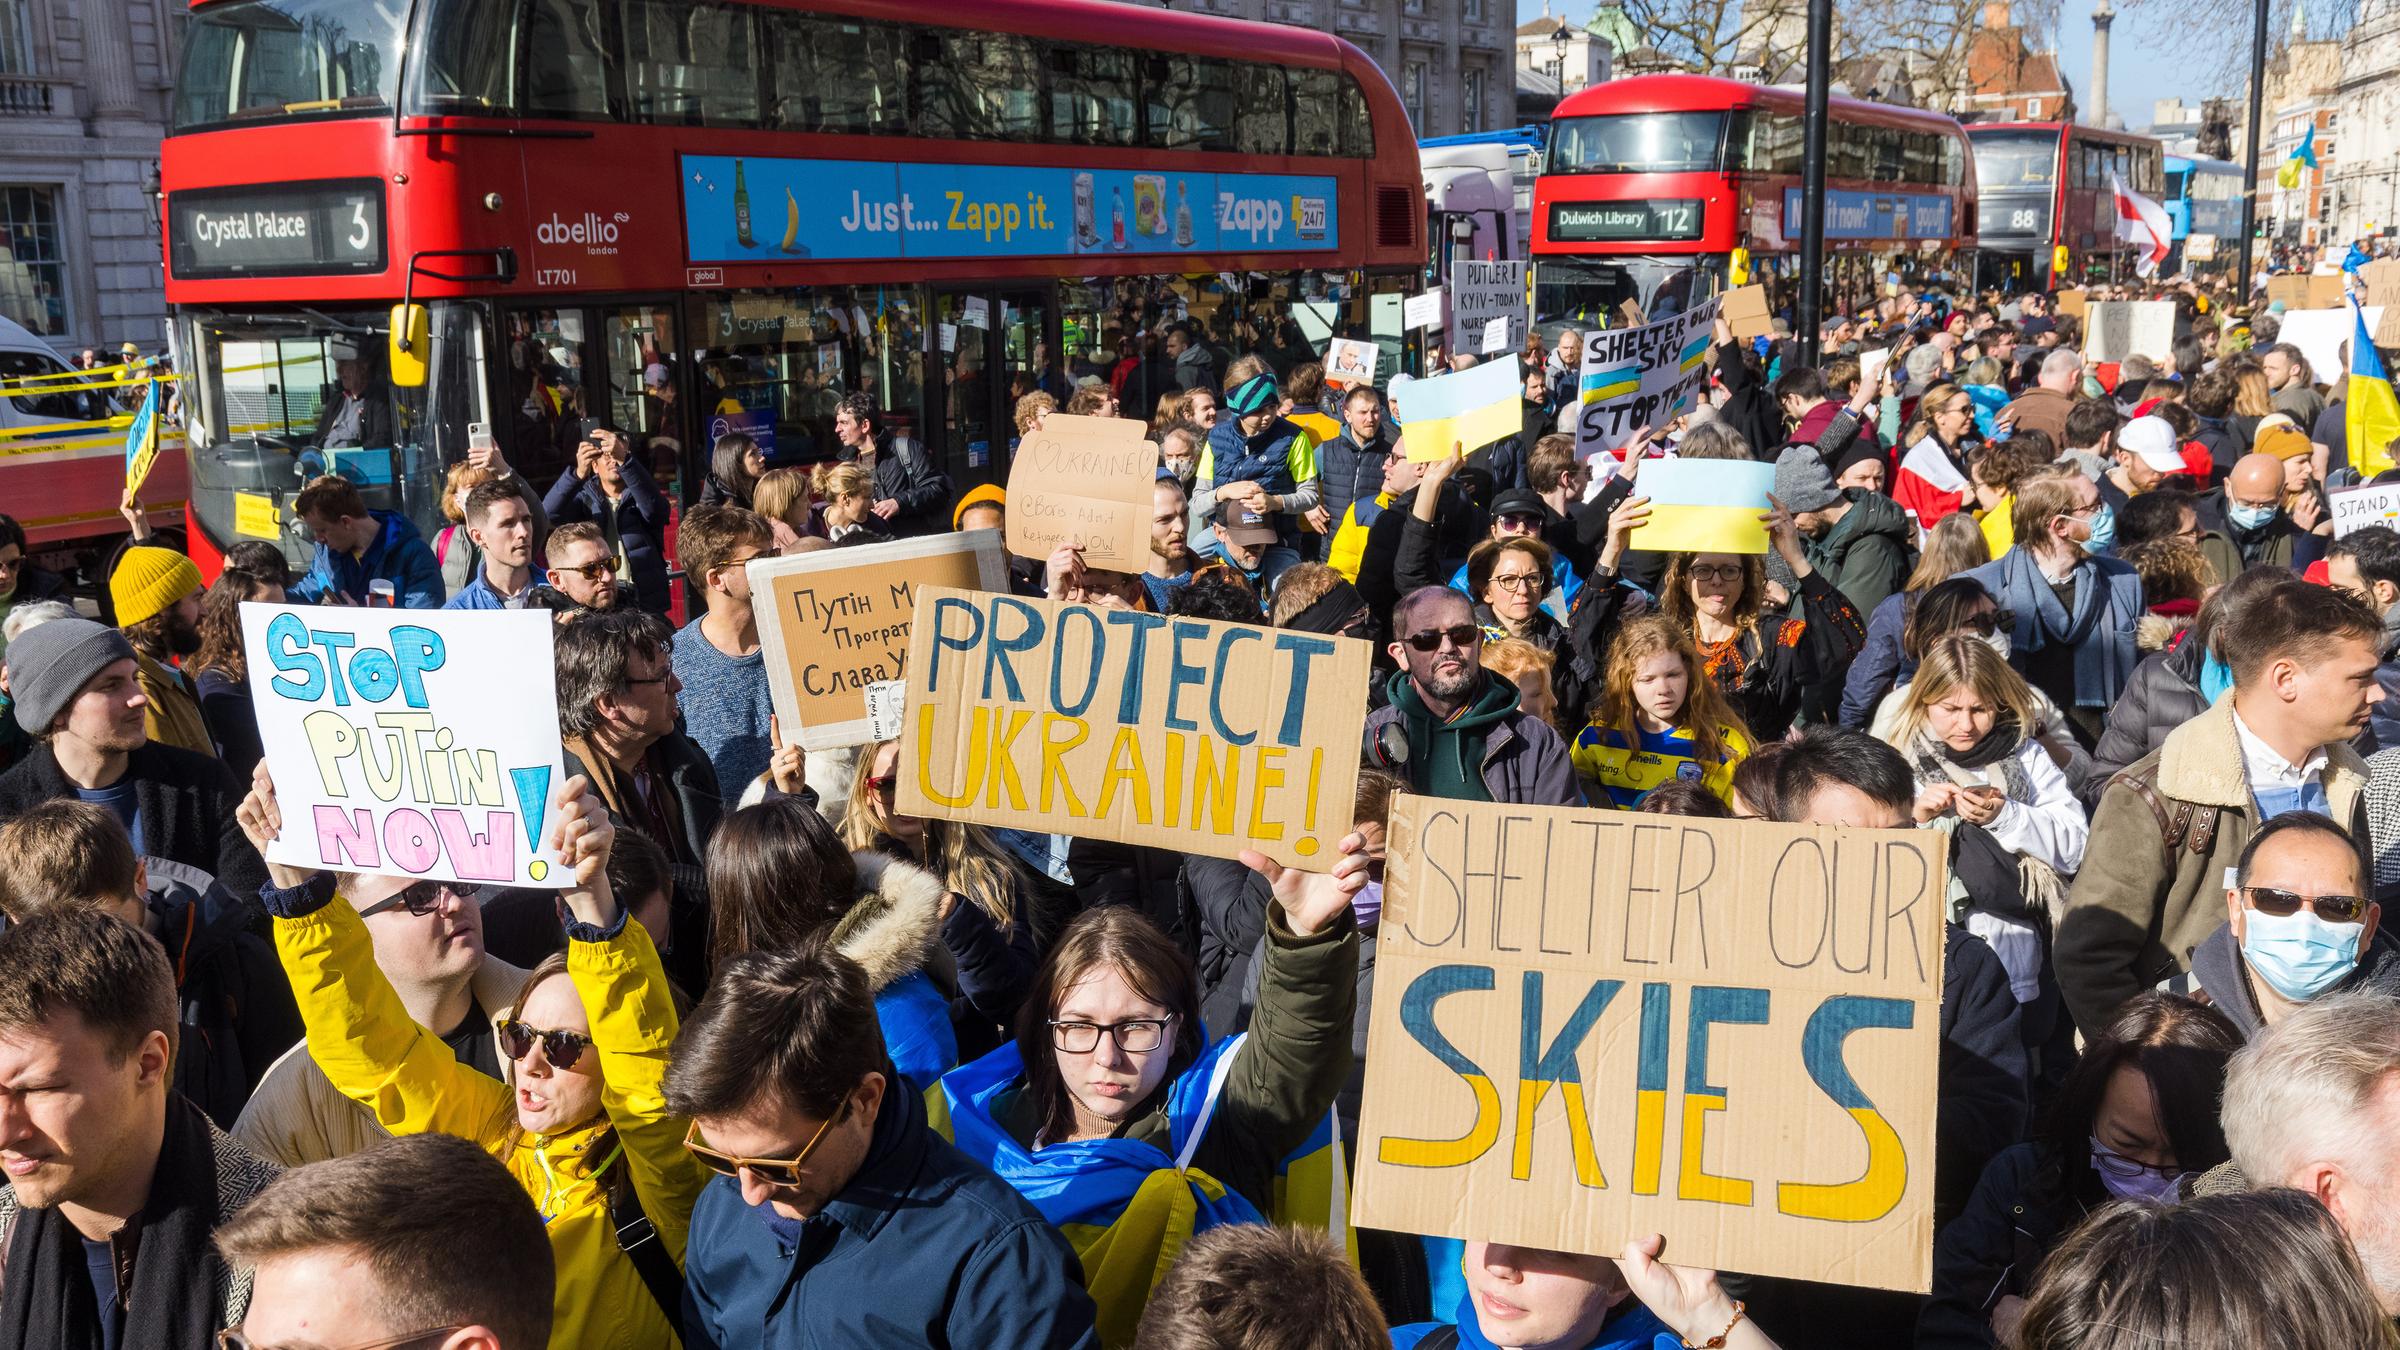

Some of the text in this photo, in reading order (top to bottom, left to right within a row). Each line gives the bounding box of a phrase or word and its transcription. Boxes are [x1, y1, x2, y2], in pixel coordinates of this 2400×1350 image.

[196, 197, 370, 250] Crystal Palace 3
[537, 212, 619, 244] abellio
[841, 190, 1054, 242] Just... Zapp it.
[1219, 192, 1283, 243] Zapp
[1304, 211, 1324, 226] 24/7
[1559, 208, 1688, 232] Dulwich Library 12
[1839, 199, 1870, 229] now?
[2012, 209, 2034, 228] 88
[587, 246, 618, 255] london
[537, 268, 577, 286] LT701
[694, 271, 716, 284] global
[1467, 262, 1516, 286] PUTLER!
[720, 312, 817, 337] 3 Crystal Palace
[1588, 318, 1686, 364] SHELTER
[1690, 303, 1716, 329] OUR
[1635, 336, 1686, 374] SKY
[1582, 394, 1660, 443] STOP
[1055, 451, 1136, 475] UKRAINE
[2339, 495, 2388, 518] STAND
[1073, 530, 1115, 551] NOW
[793, 588, 873, 635] Путін
[833, 620, 913, 650] Програт
[266, 612, 446, 709] STOP
[927, 597, 1336, 747] PROTECT
[802, 662, 889, 697] Слава
[1634, 754, 1662, 766] neills
[917, 702, 1324, 857] UKRAINE!
[1404, 811, 1929, 984] SHELTER OUR
[1378, 964, 1916, 1224] SKIES
